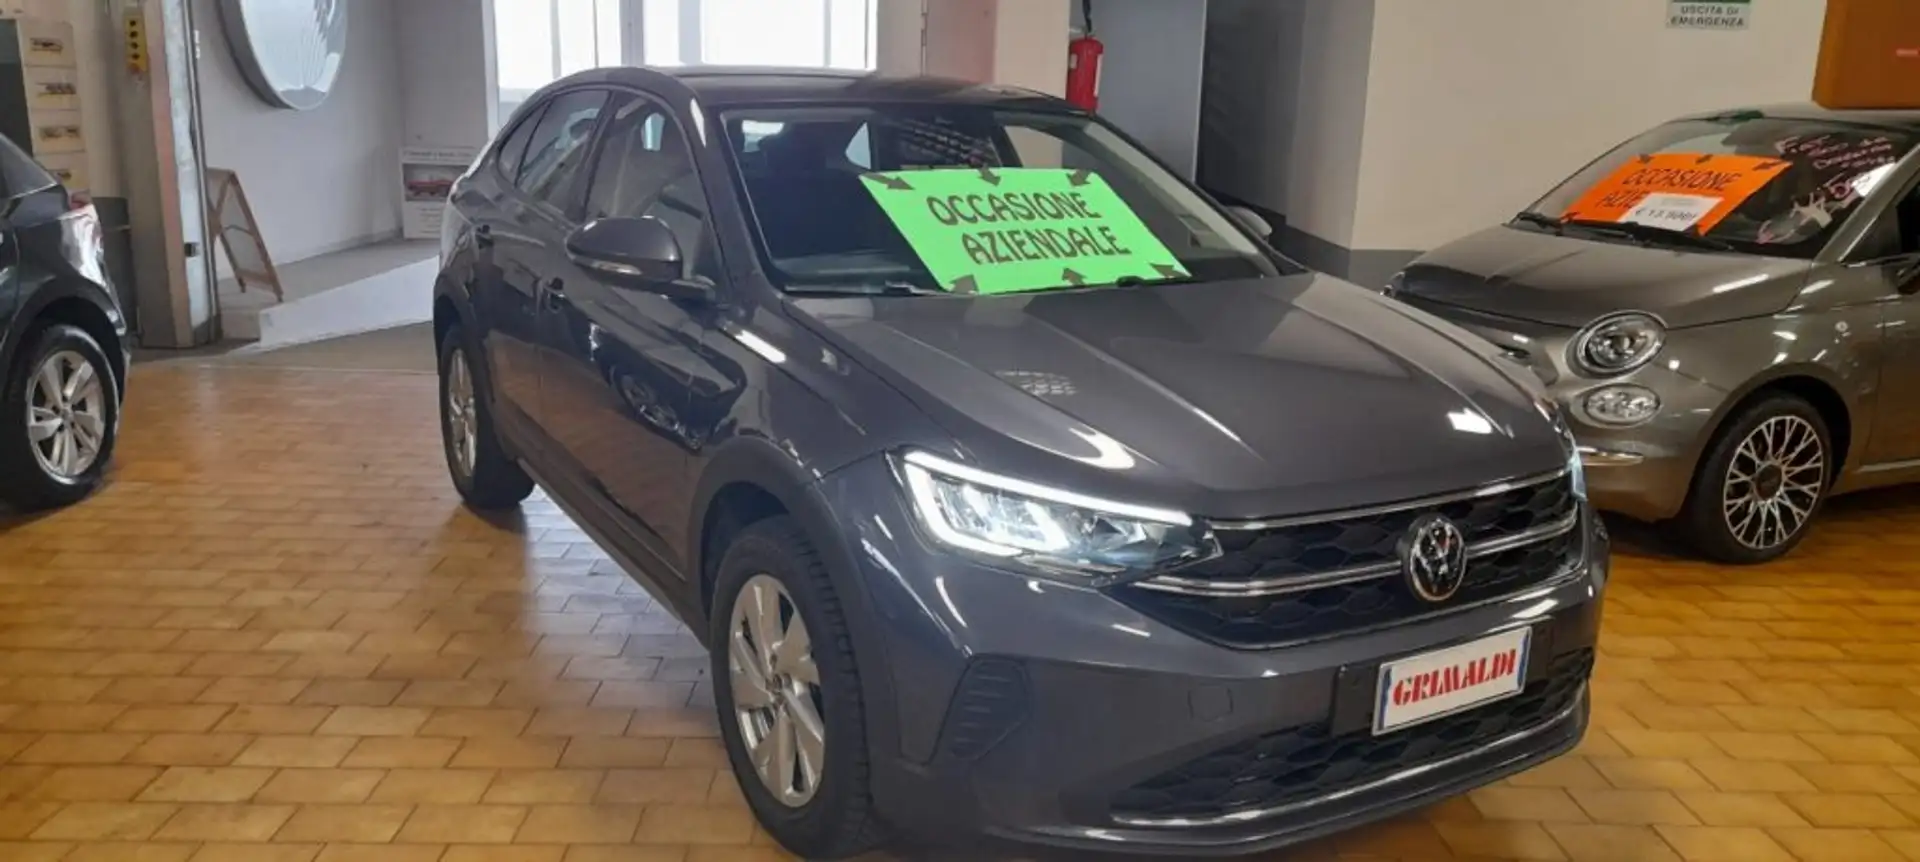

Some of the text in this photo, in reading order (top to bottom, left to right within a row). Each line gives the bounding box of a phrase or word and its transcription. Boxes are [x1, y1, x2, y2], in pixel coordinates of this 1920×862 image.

[1670, 16, 1744, 26] EMERGENZA
[1681, 5, 1739, 15] USCITA DI
[1622, 168, 1742, 192] OCCASIONE
[926, 192, 1102, 226] OCCASIONE
[1595, 189, 1649, 209] AZIE
[962, 226, 1132, 265] AZIENDALE
[1393, 648, 1517, 706] GRIMALDI
